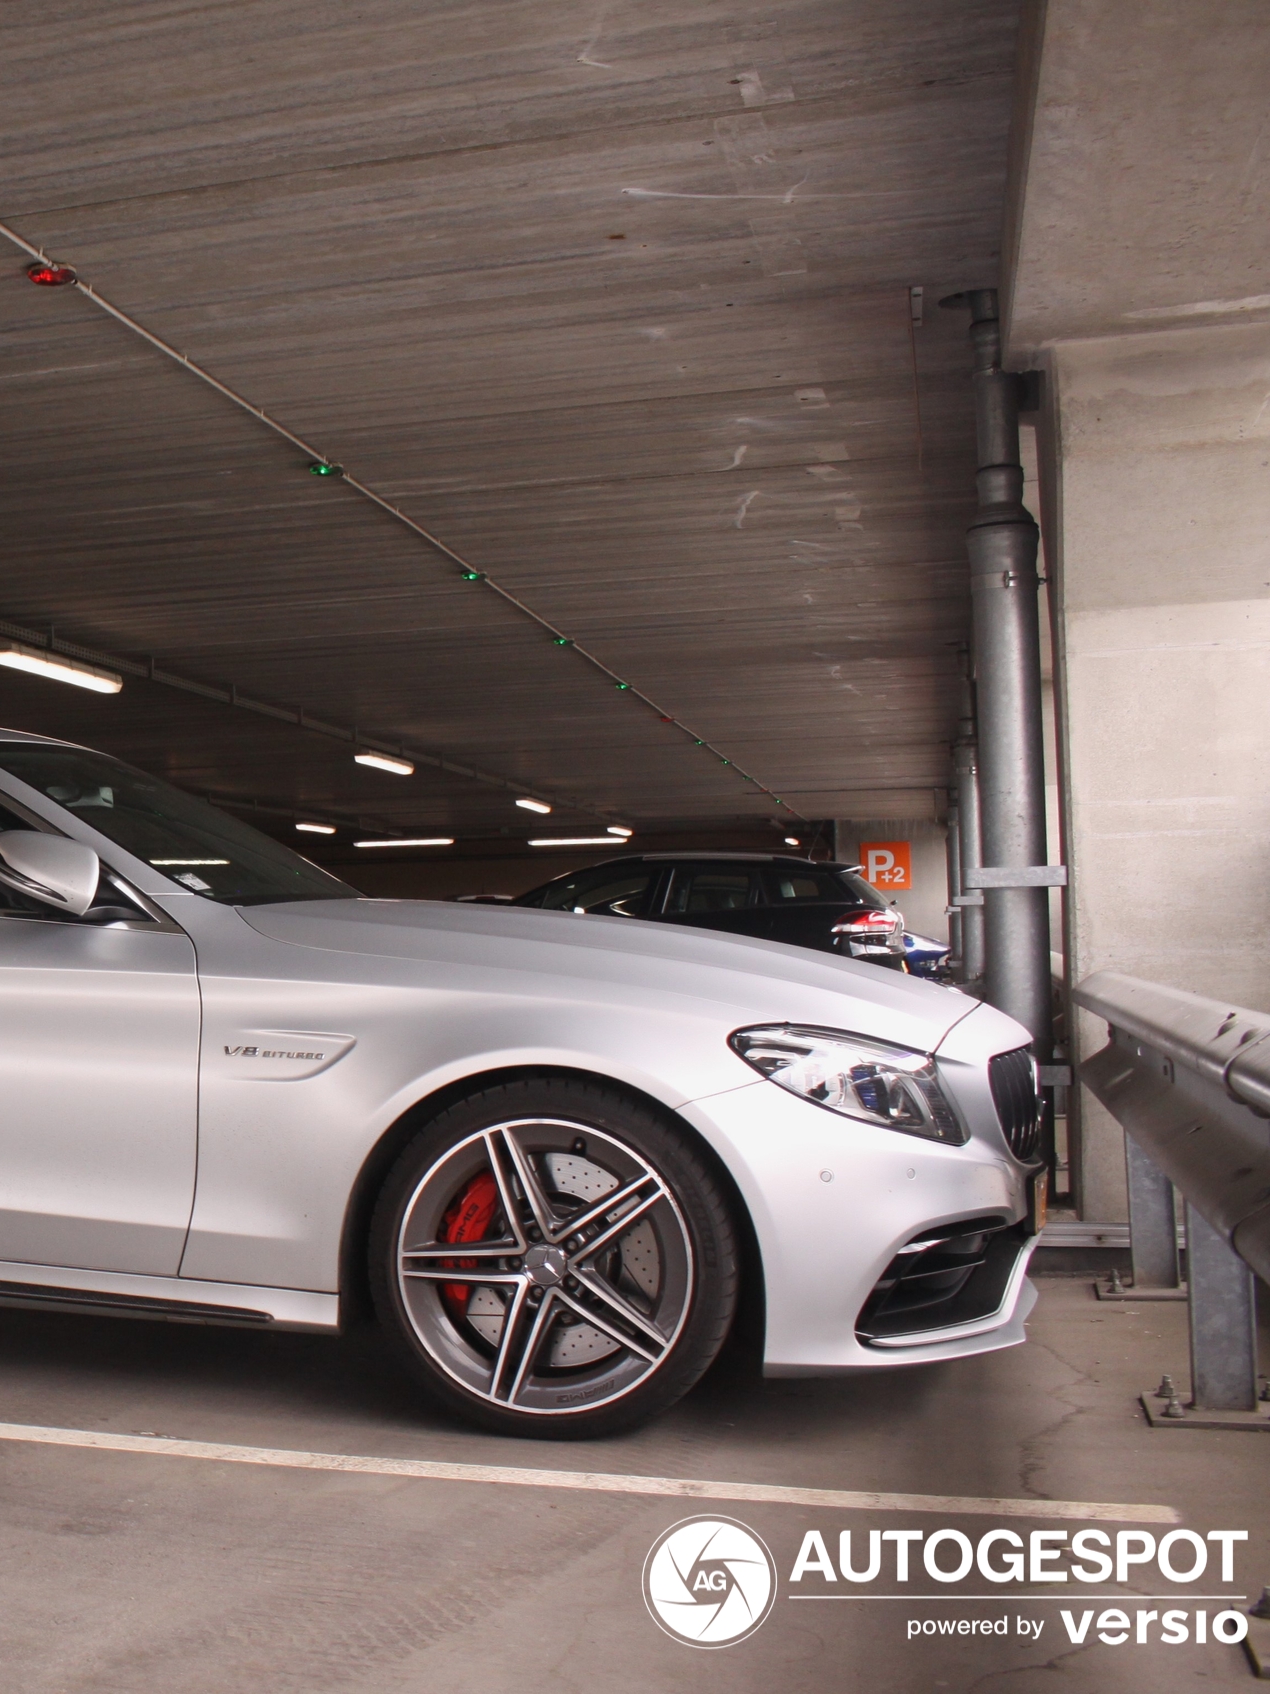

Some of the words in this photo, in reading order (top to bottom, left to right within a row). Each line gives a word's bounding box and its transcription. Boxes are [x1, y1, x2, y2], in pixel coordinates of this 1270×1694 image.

[868, 850, 895, 883] P
[881, 867, 905, 883] +2
[223, 1045, 259, 1058] V8
[262, 1050, 325, 1060] BITURBO
